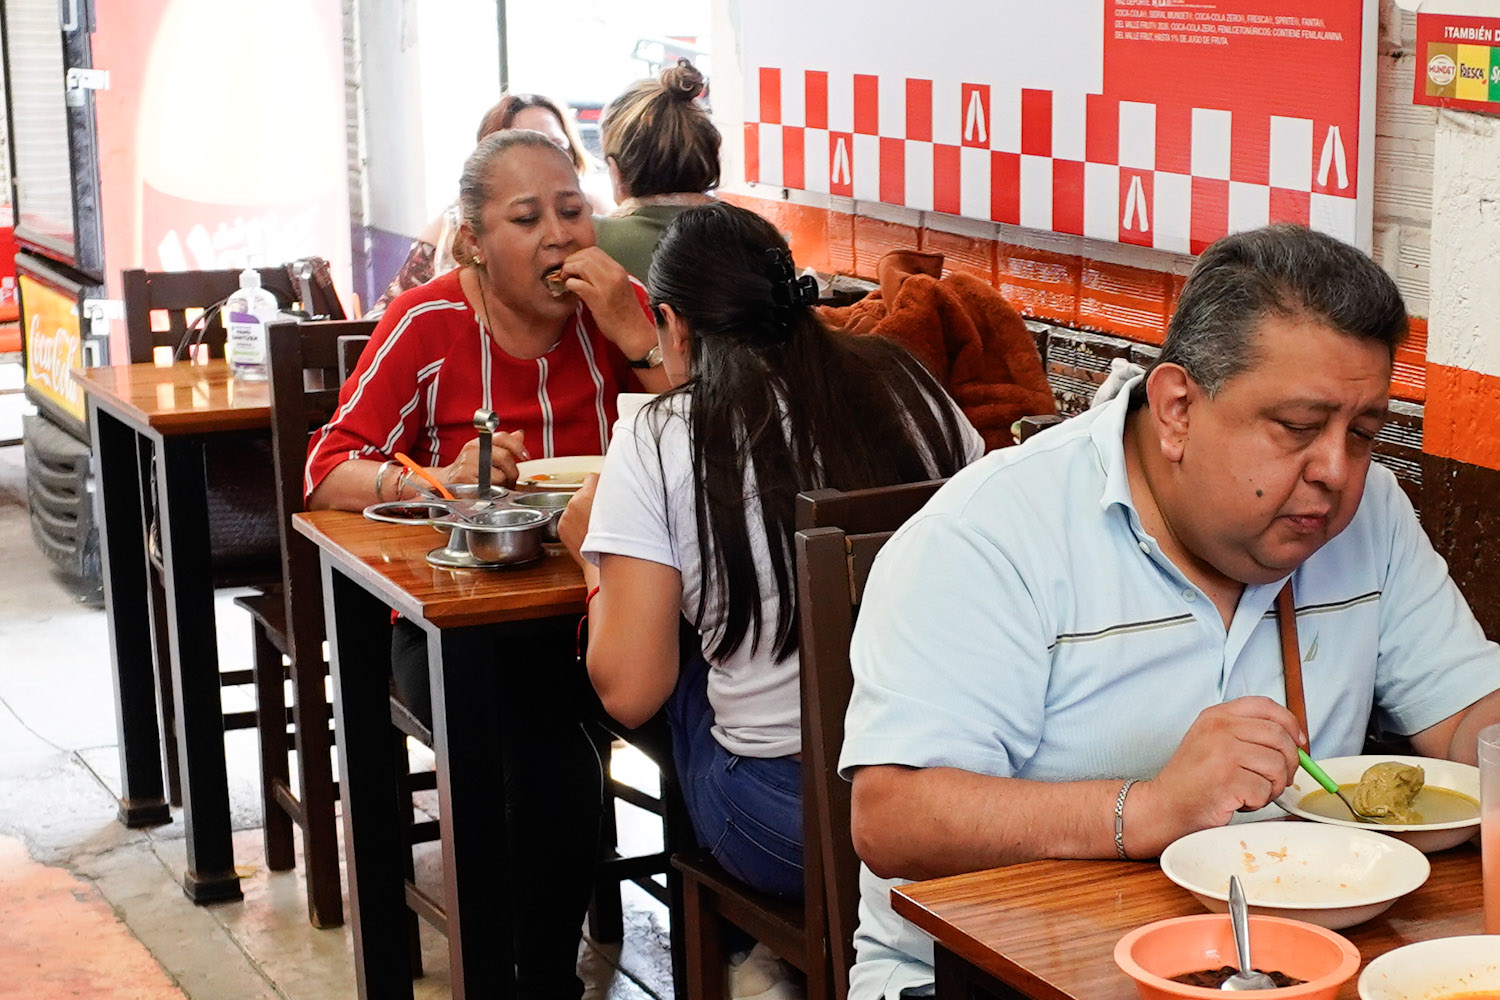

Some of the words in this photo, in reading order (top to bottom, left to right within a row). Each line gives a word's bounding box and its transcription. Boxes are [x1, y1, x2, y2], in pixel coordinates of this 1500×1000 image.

[1194, 12, 1226, 22] COCA-COLA
[1170, 22, 1201, 32] COCA-COLA
[1272, 28, 1301, 39] CONTIENE
[1444, 26, 1492, 42] ¡TAMBIÉN
[1460, 63, 1484, 79] FRESCA
